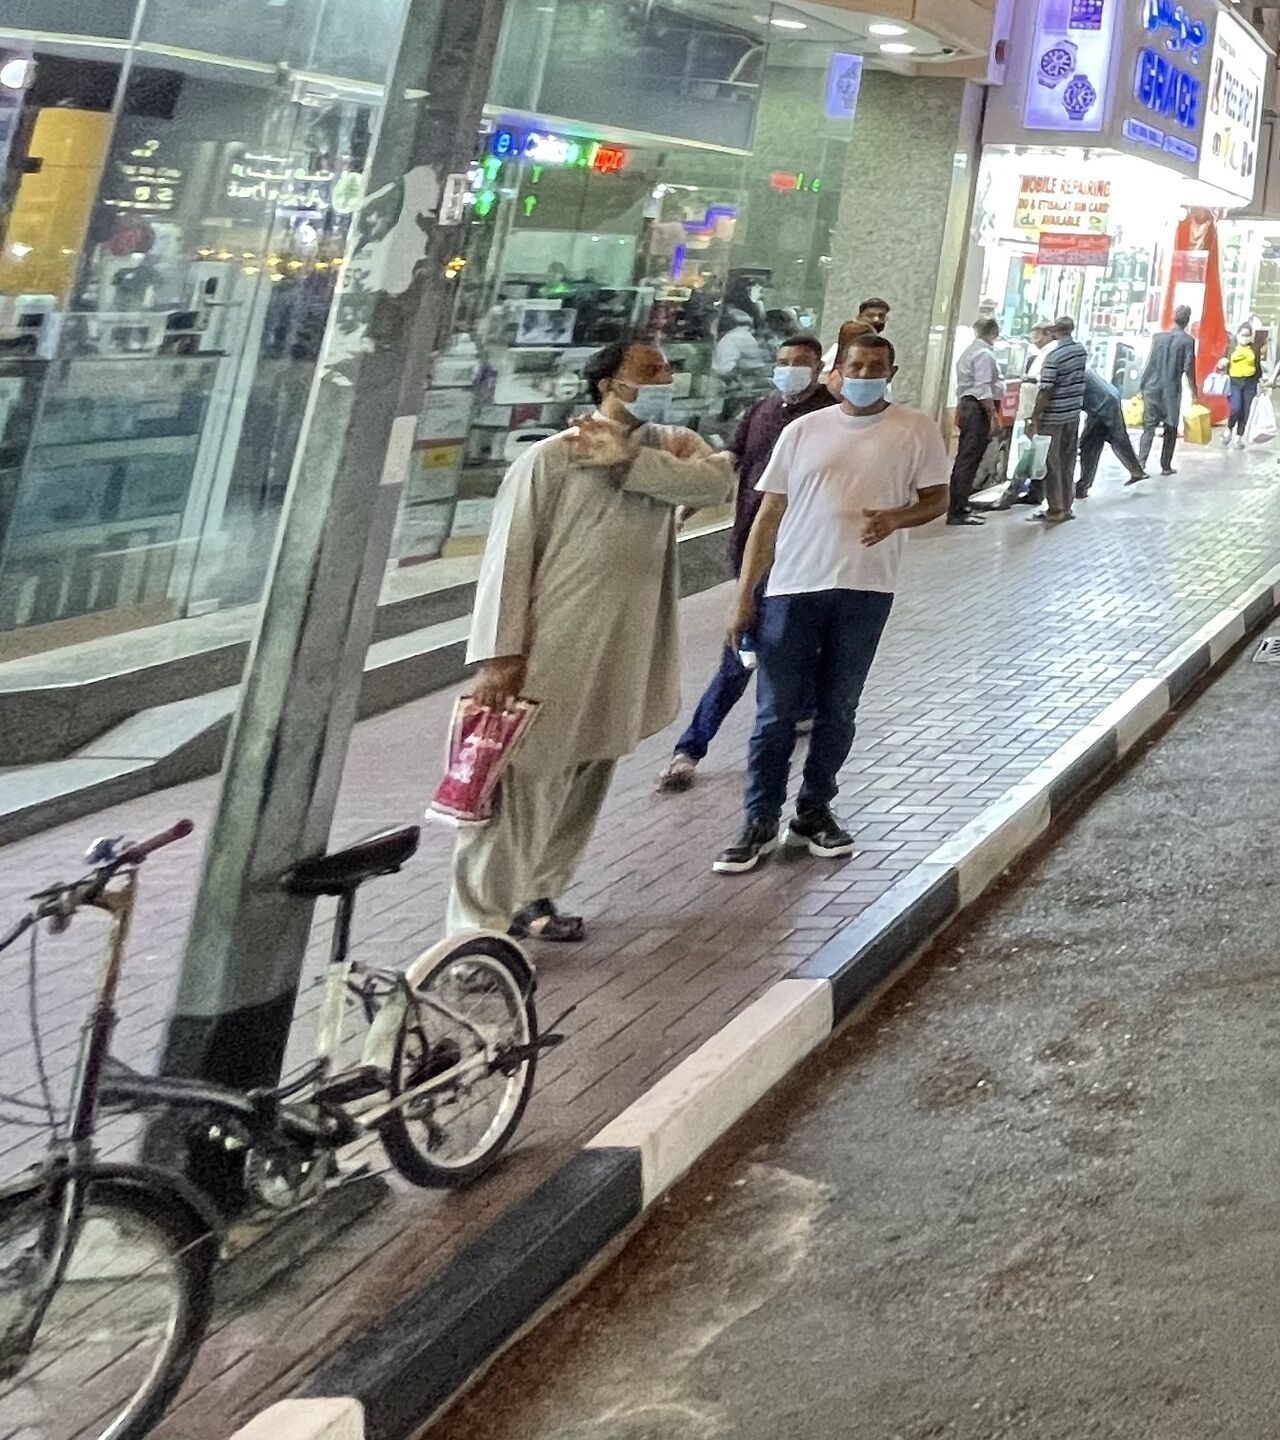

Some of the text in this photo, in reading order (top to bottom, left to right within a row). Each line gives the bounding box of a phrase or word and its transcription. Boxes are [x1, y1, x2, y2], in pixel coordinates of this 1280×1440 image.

[1020, 175, 1112, 197] MOBILE REPAIRING
[1041, 215, 1081, 227] AVAILABLE
